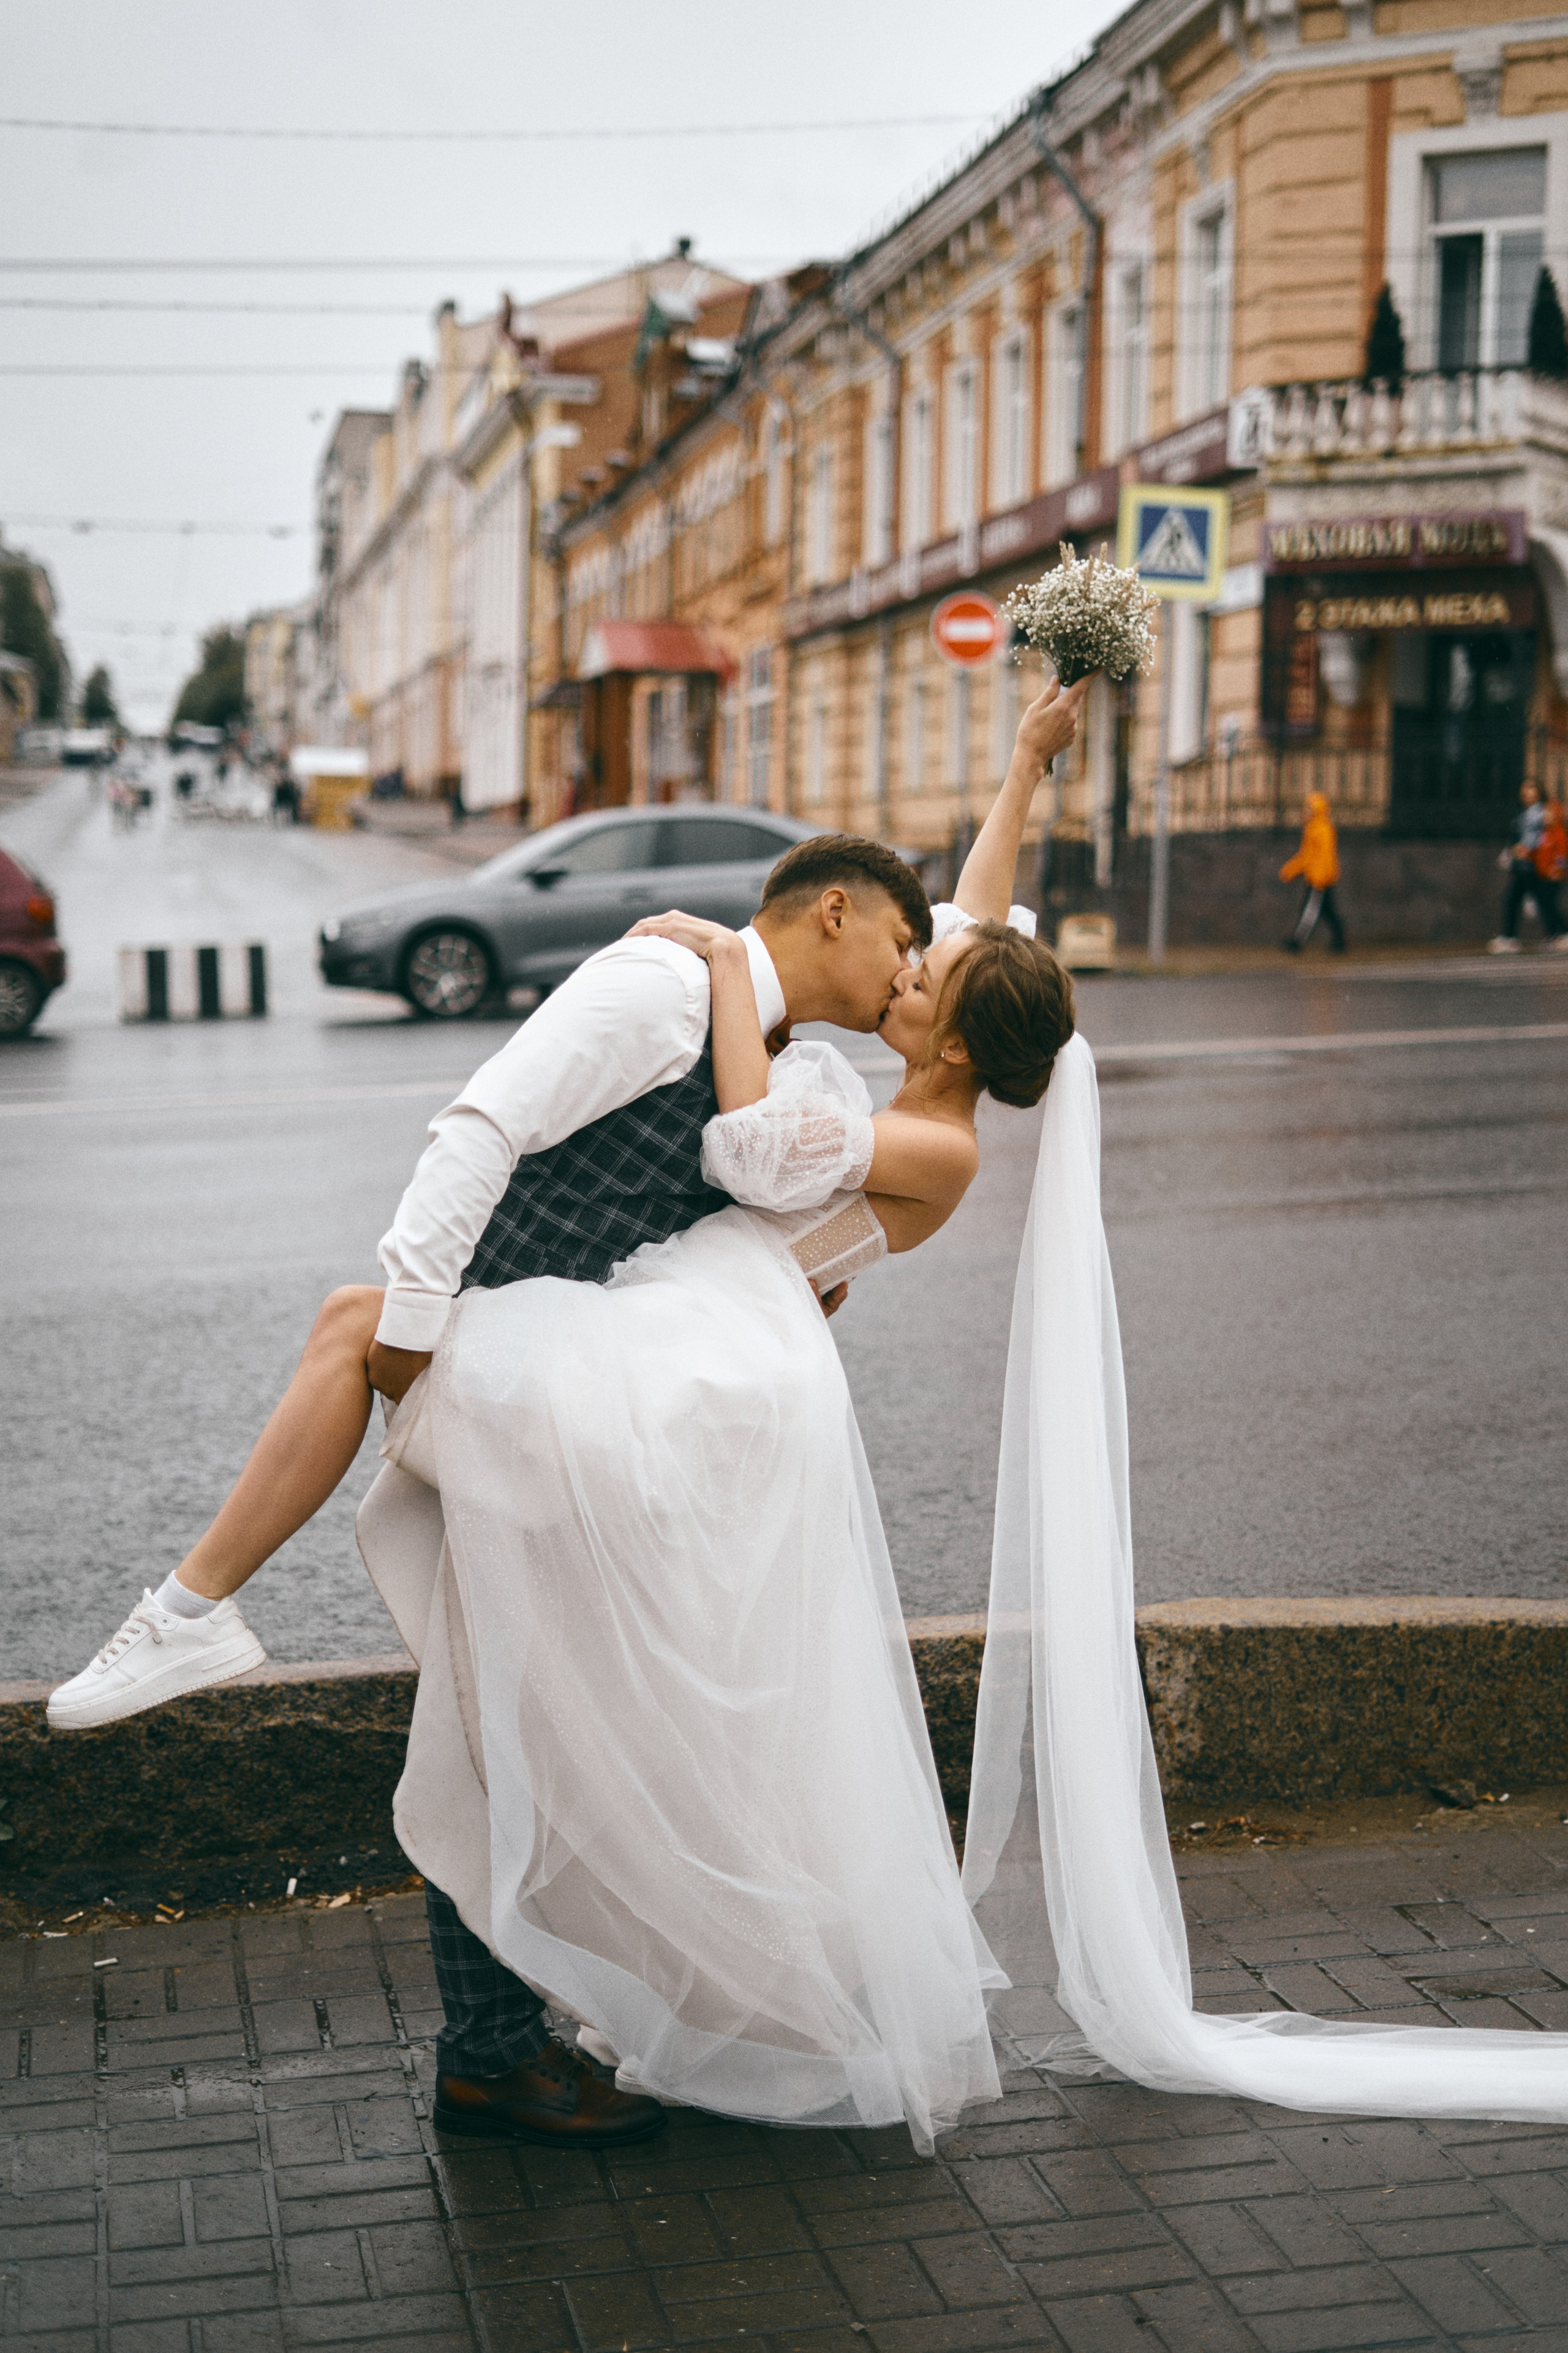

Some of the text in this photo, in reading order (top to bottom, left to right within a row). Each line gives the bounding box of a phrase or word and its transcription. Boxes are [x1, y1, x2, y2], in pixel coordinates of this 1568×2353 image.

[1295, 591, 1512, 632] 2 ЭТАЖА МЕХА
